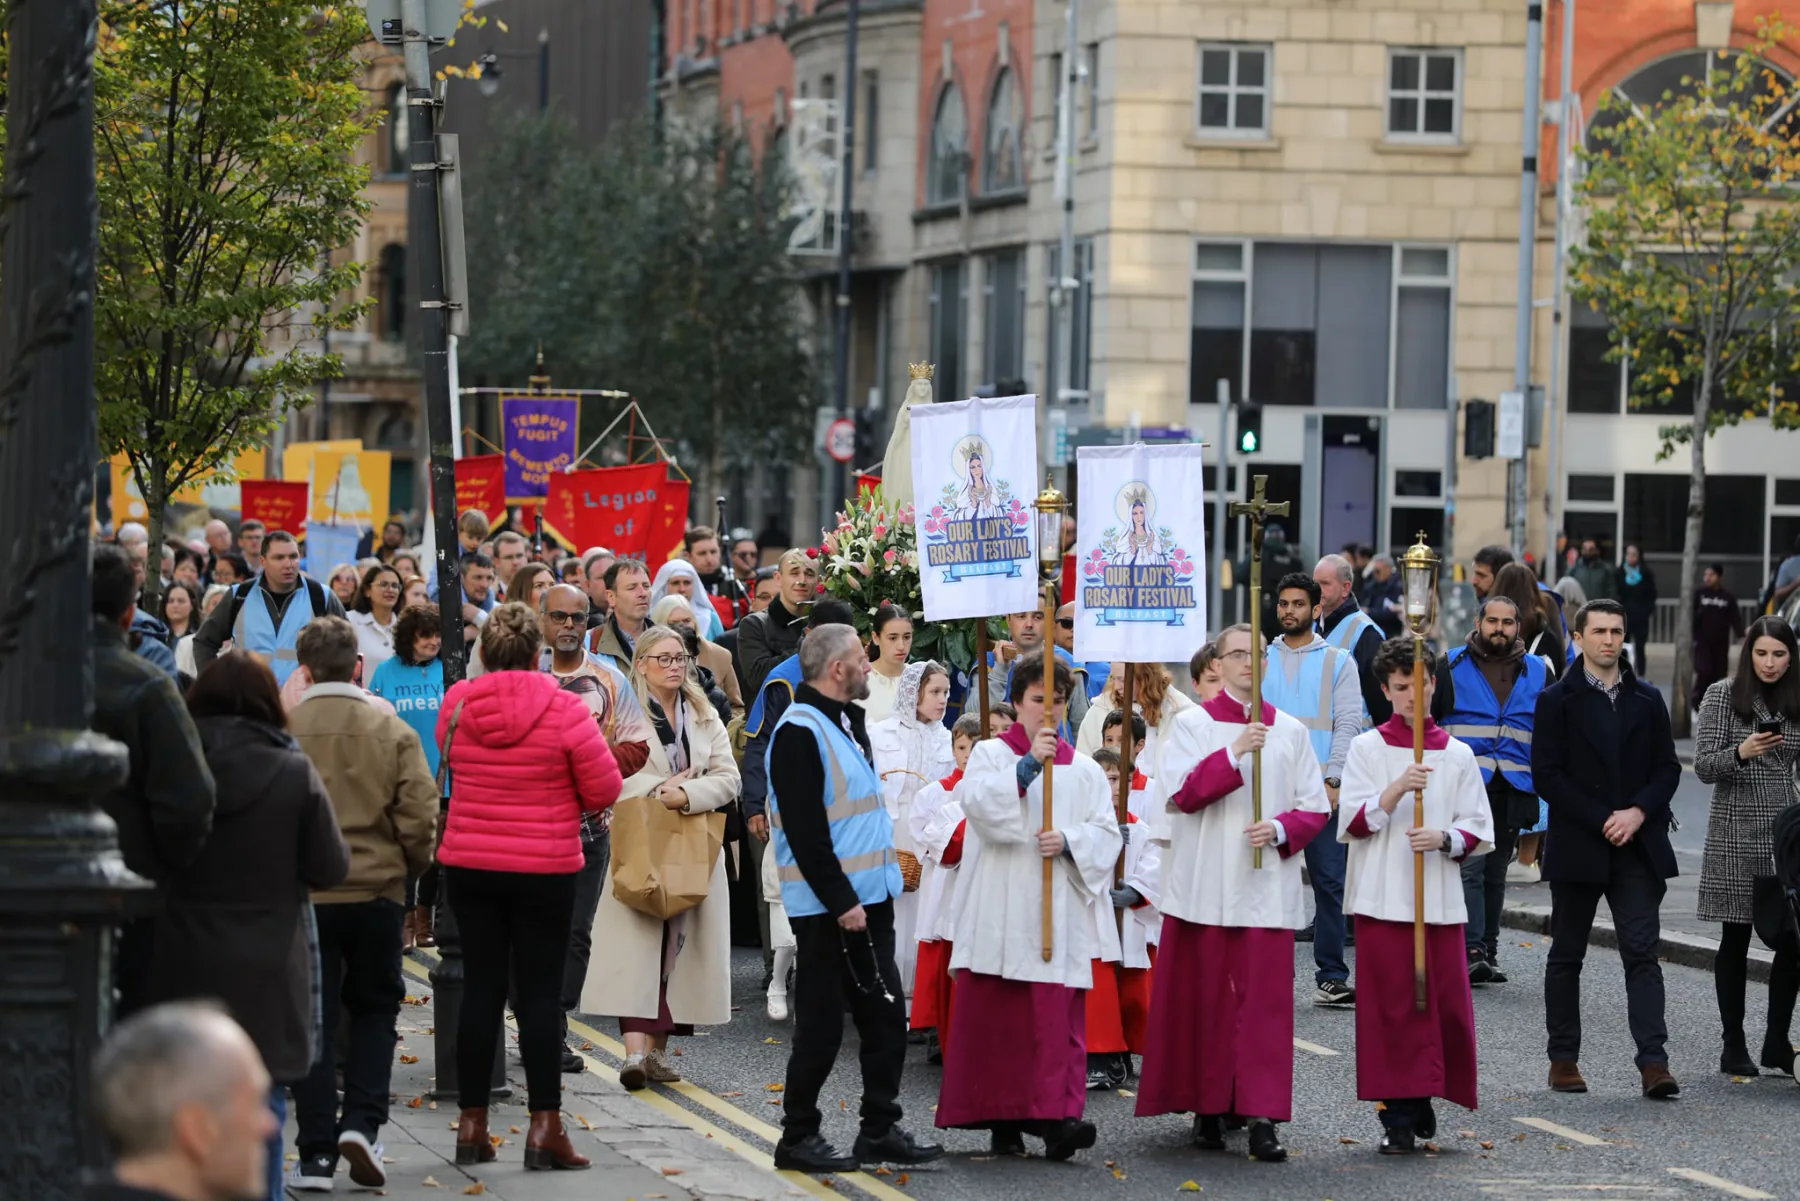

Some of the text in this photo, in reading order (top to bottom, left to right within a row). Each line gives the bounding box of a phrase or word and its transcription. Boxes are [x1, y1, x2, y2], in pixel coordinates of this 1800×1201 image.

[511, 413, 568, 432] TEMPUS
[518, 428, 558, 441] FUGIT
[510, 448, 570, 473] MEMENTO
[584, 488, 656, 510] Legion
[614, 518, 633, 535] of
[948, 518, 1012, 542] OUR LADY'S
[929, 538, 1030, 564] ROSARY FESTIVAL
[960, 562, 1008, 574] BELFAST
[1105, 566, 1174, 586] OUR LADY'S
[1085, 587, 1195, 607] ROSARY FESTIVAL
[1115, 610, 1167, 619] BELFAST
